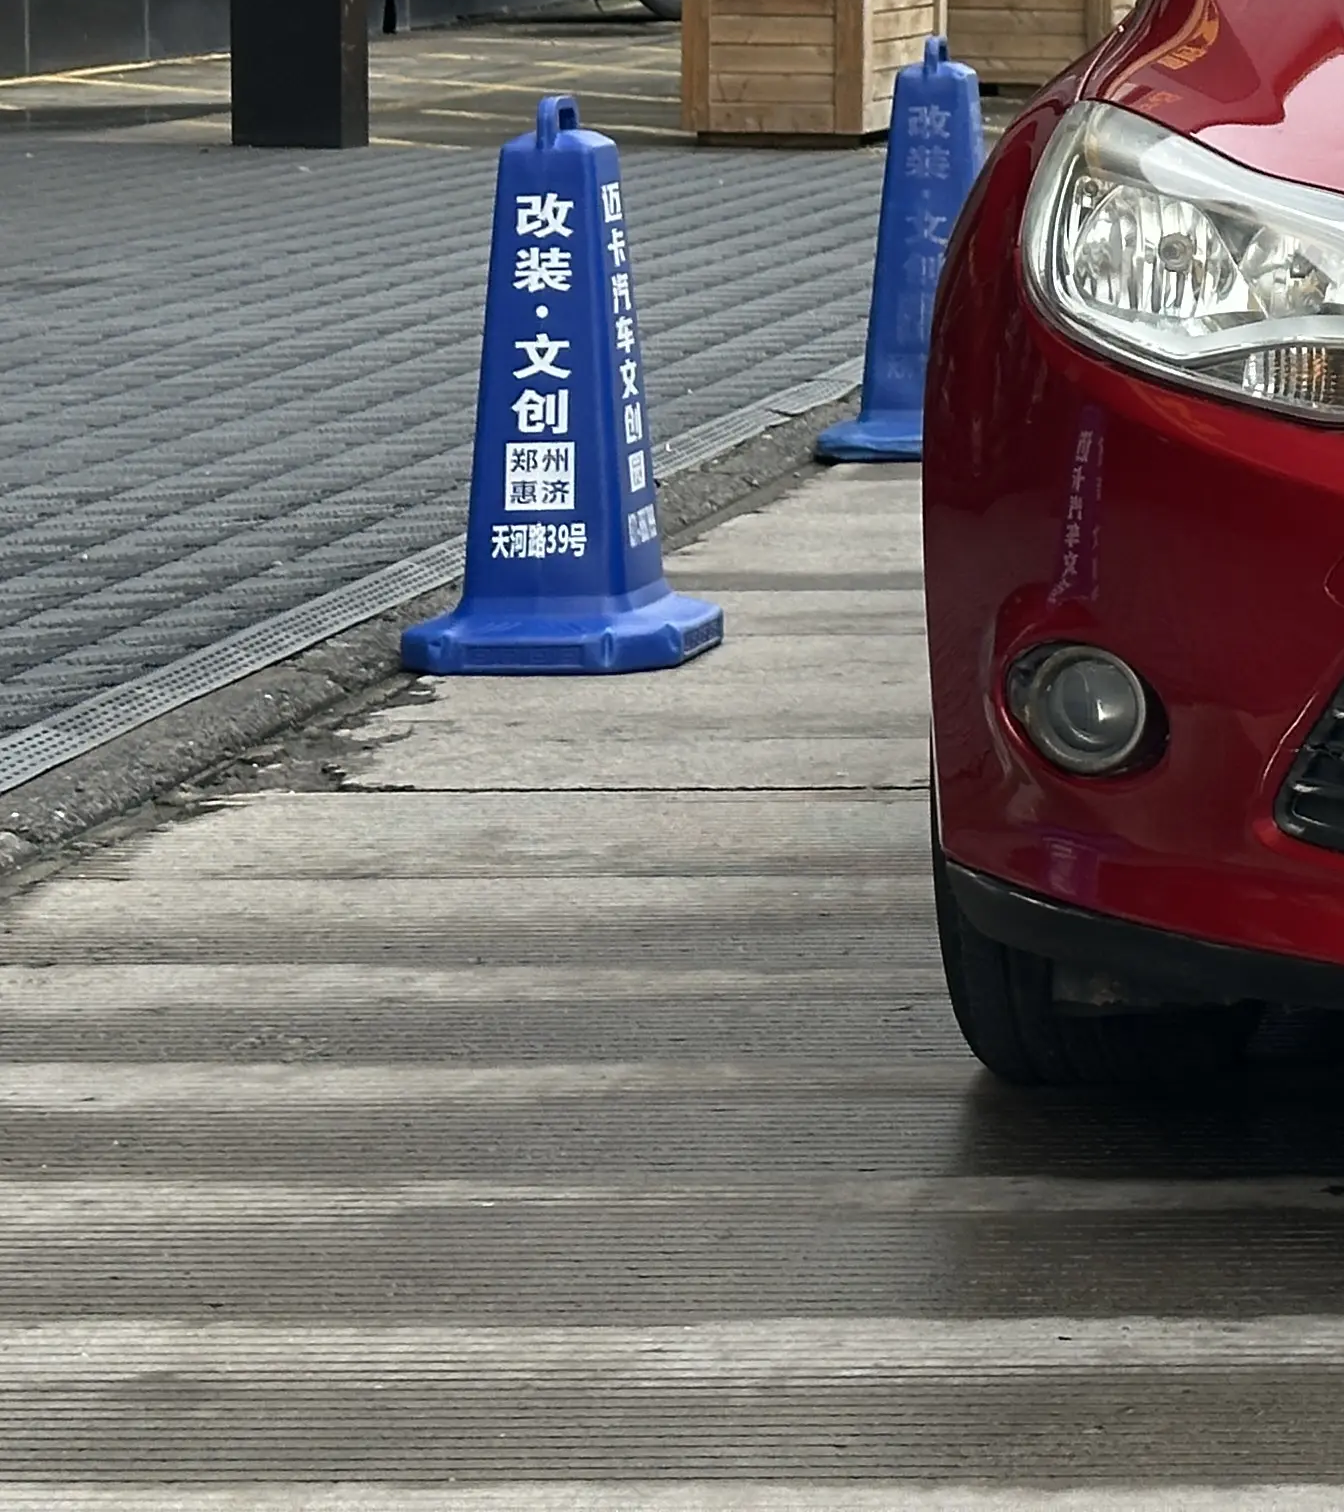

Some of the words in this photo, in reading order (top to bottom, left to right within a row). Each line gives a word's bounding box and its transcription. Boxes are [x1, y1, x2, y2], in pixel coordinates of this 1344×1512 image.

[511, 192, 575, 435] 改装·文创
[510, 447, 569, 472] 郑州
[509, 480, 570, 504] 惠济
[491, 521, 588, 559] 天河路39号
